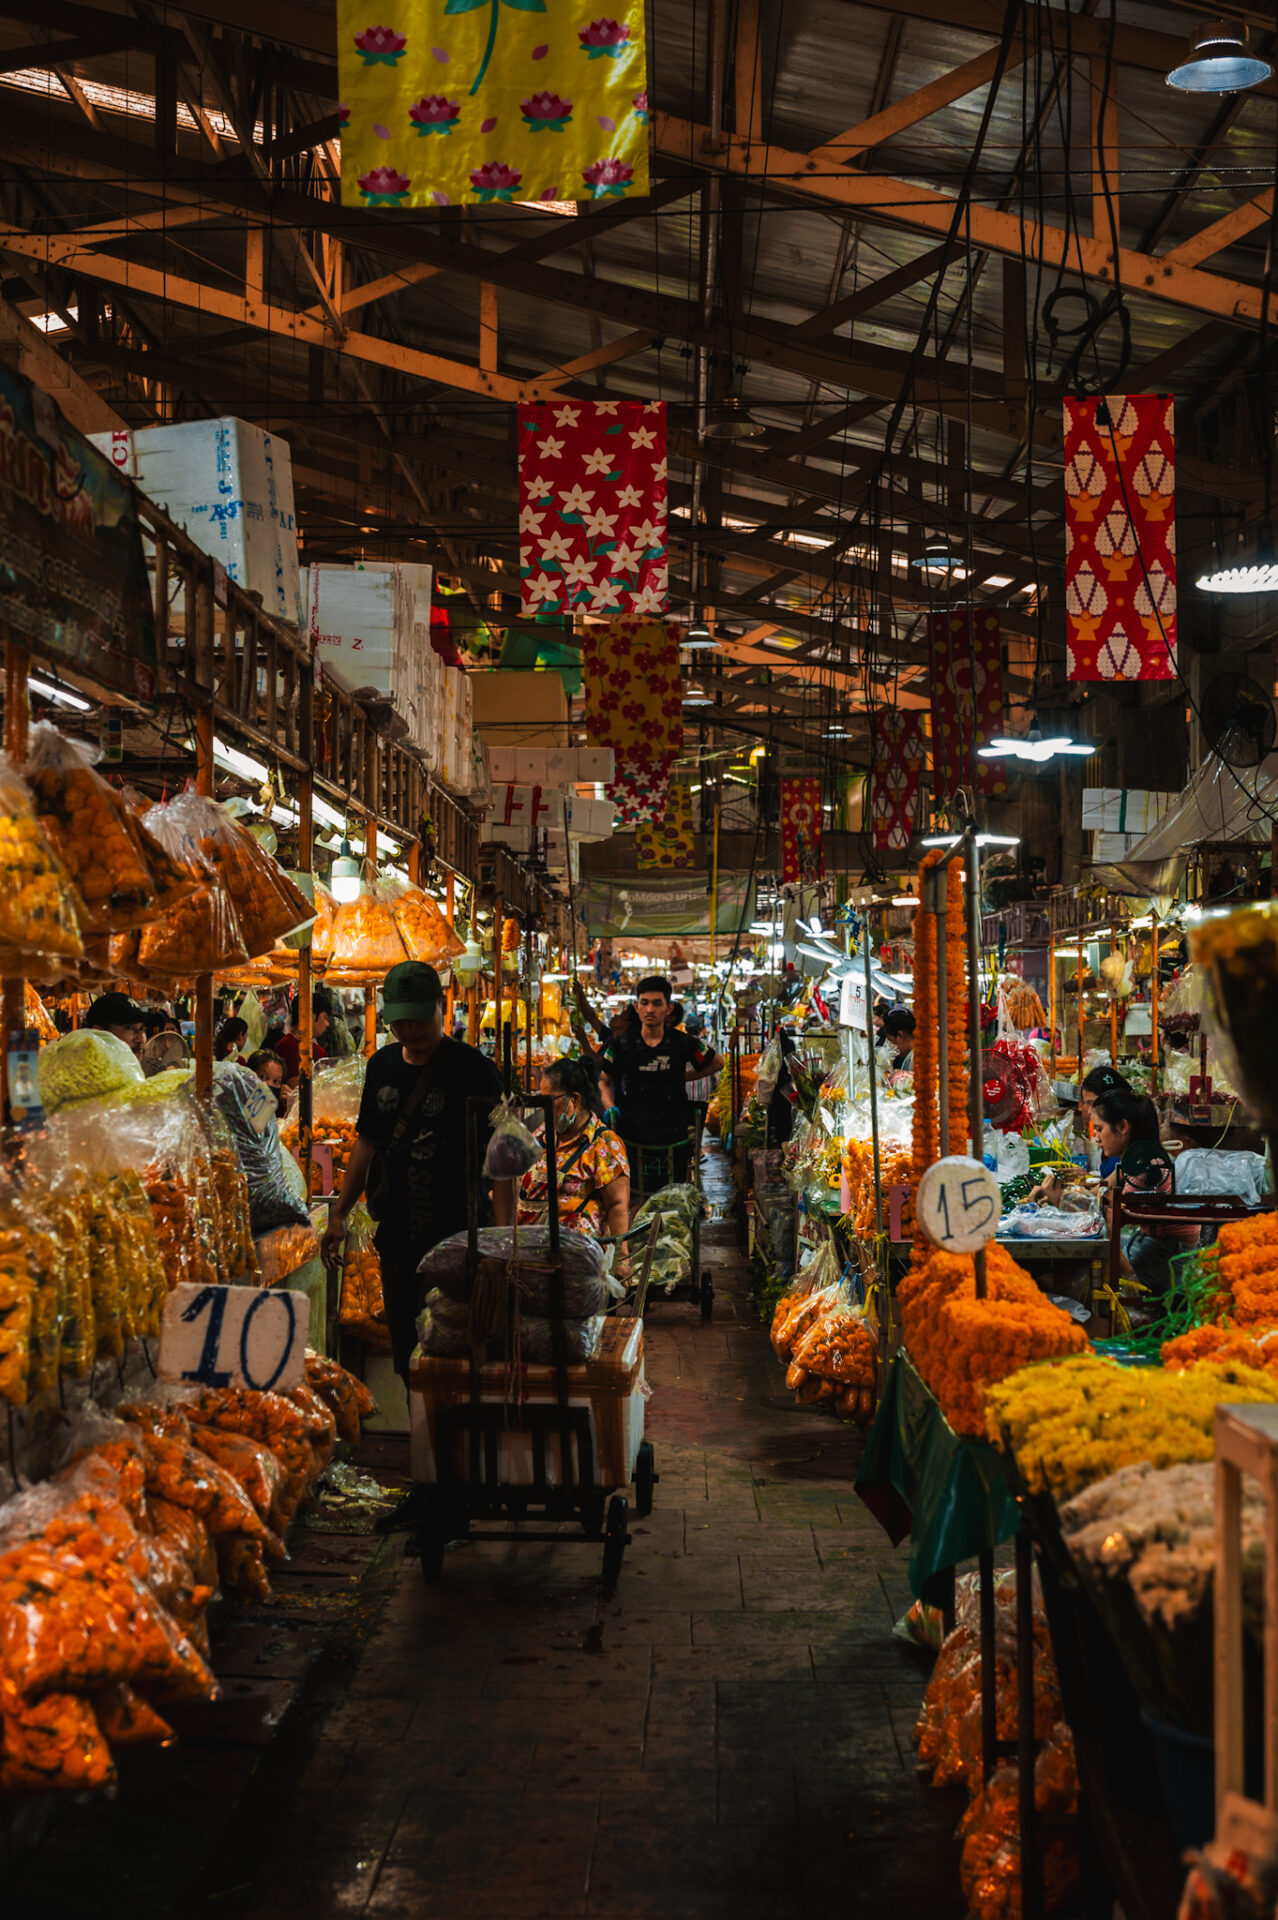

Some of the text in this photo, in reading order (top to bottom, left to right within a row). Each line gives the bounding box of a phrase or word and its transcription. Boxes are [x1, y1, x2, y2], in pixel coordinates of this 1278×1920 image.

[247, 1089, 266, 1118] 20
[937, 1178, 994, 1240] 15
[181, 1286, 296, 1391] 10
